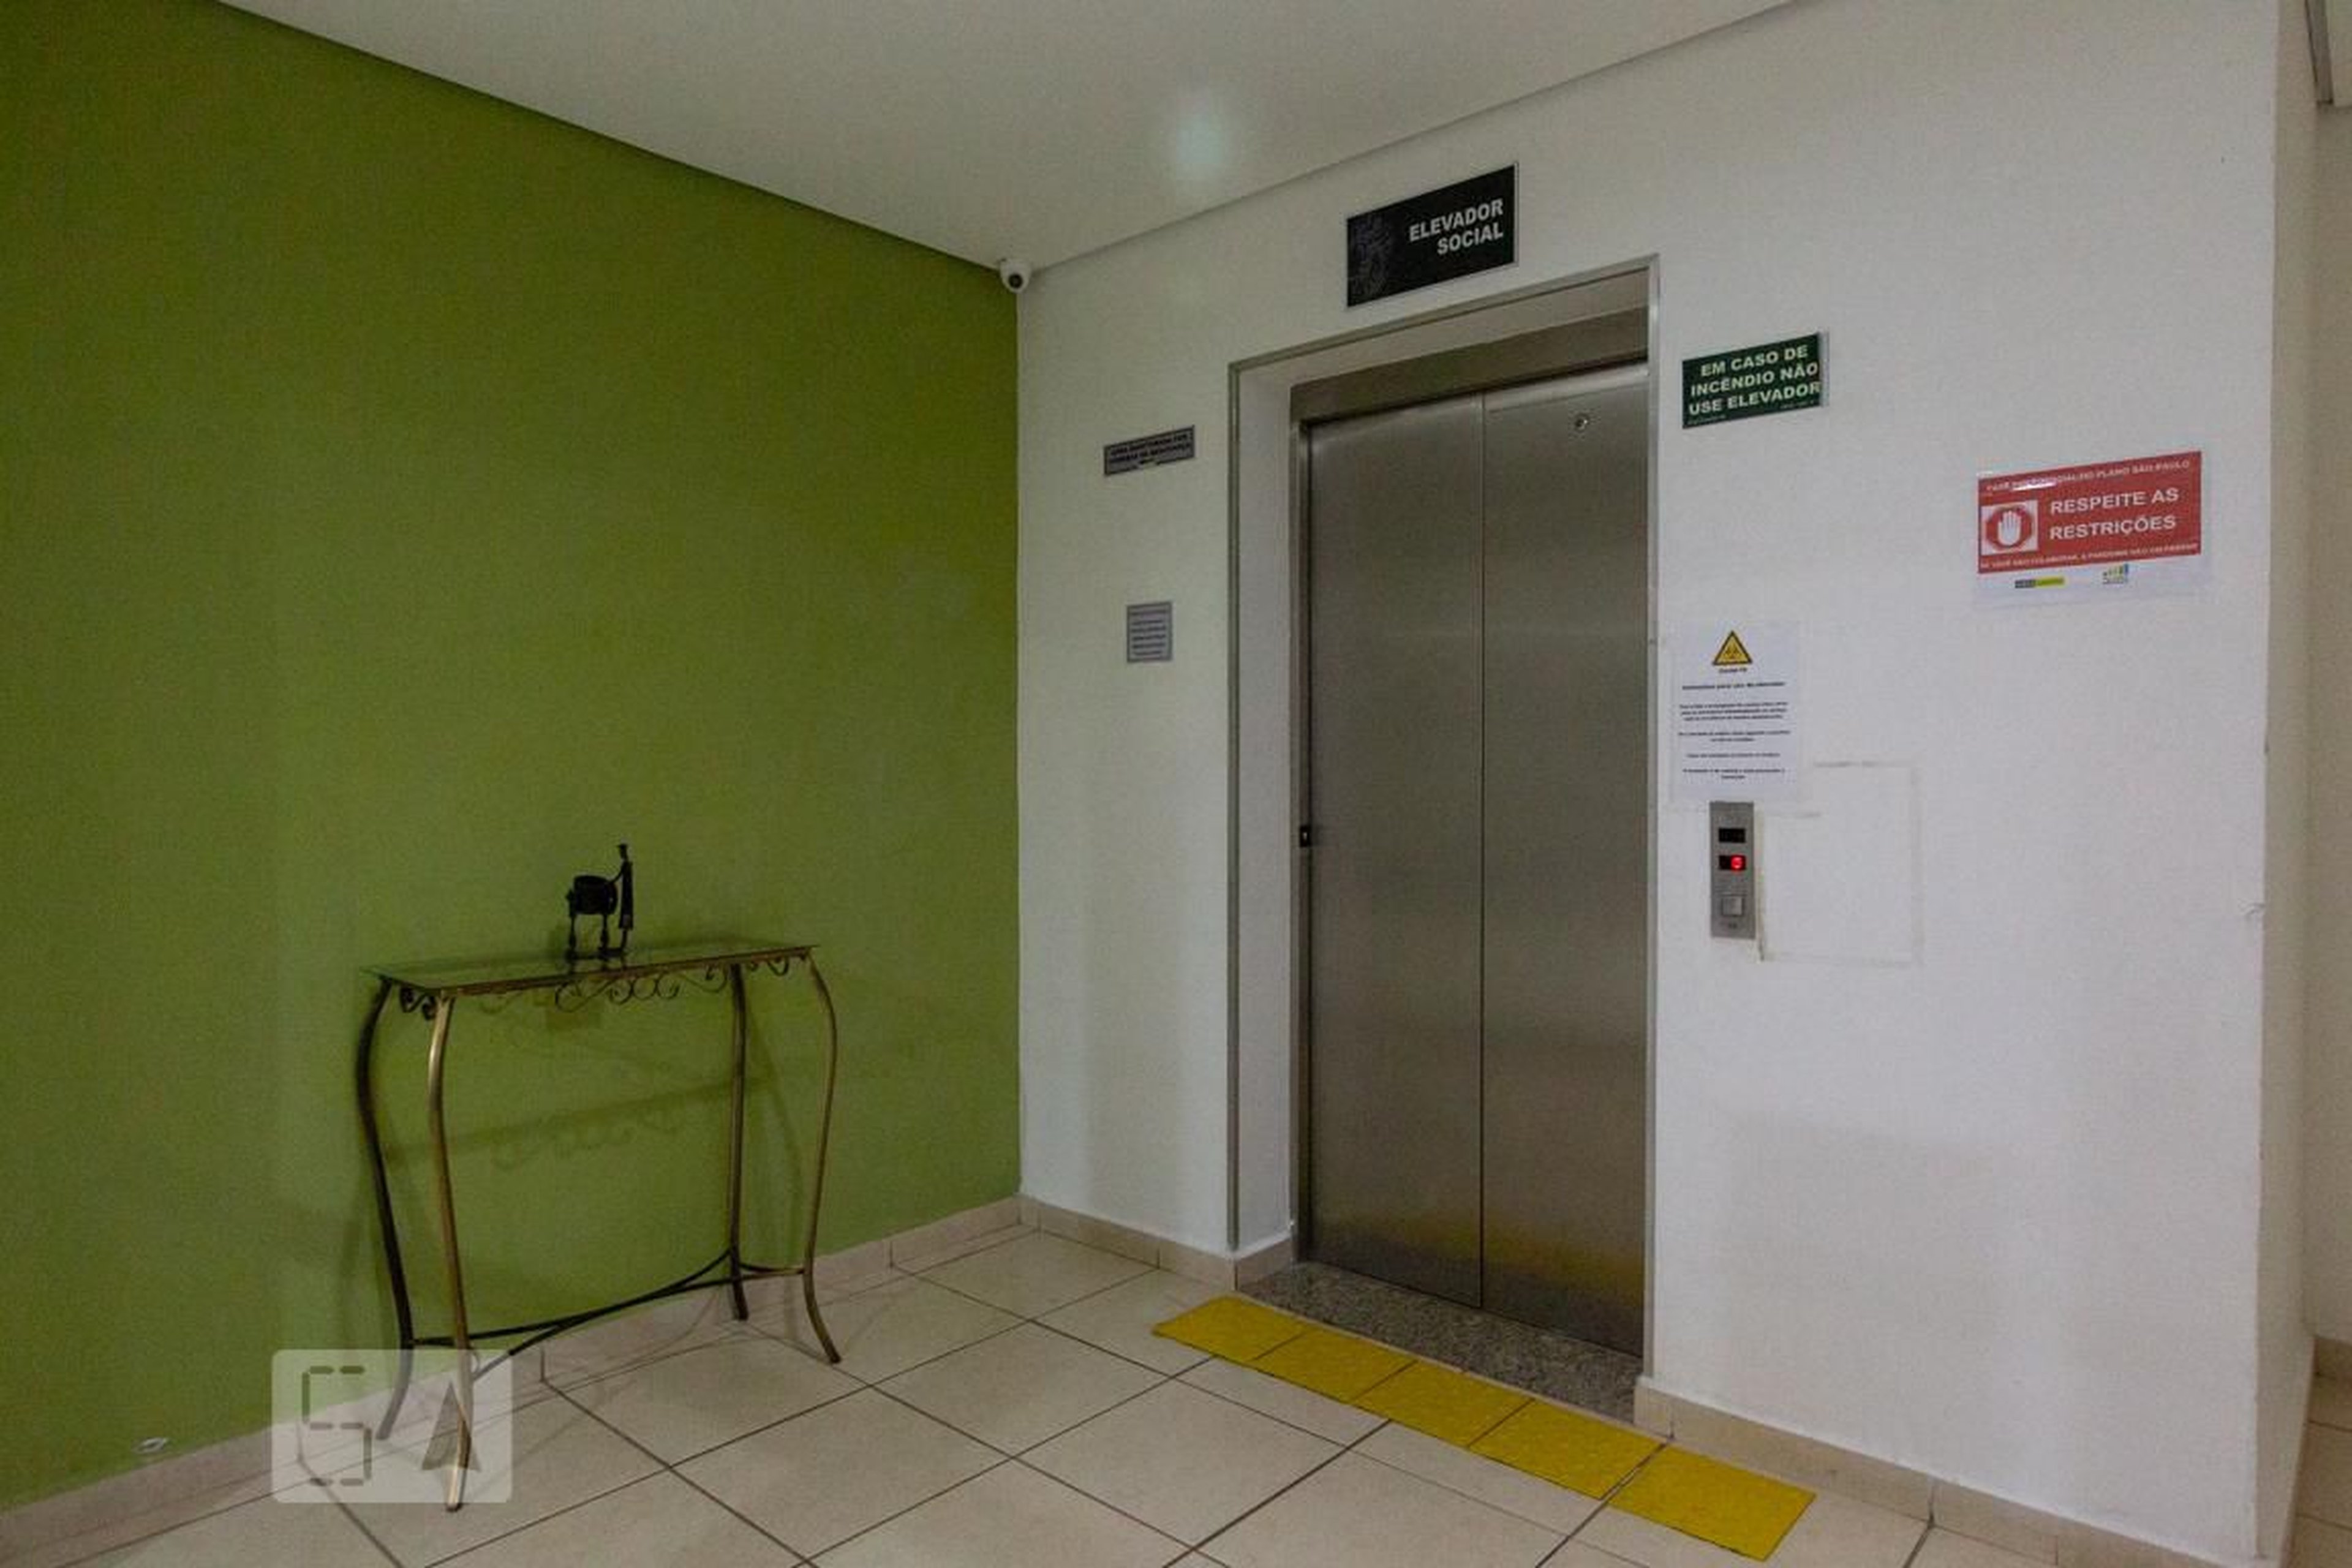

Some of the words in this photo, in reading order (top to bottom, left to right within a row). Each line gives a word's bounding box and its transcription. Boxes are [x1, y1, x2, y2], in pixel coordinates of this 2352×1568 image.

[1409, 198, 1503, 242] ELEVADOR
[1438, 222, 1503, 255] SOCIAL
[1701, 361, 1725, 377] EM
[1731, 351, 1779, 371] CASO
[1784, 345, 1808, 361] DE
[1780, 362, 1818, 380] NÃO
[1689, 398, 1722, 415] USE
[1728, 382, 1821, 409] ELEVADOR
[2051, 492, 2146, 515] RESPEITE
[2152, 488, 2179, 503] AS
[2050, 514, 2176, 540] RESTRIÇÕES
